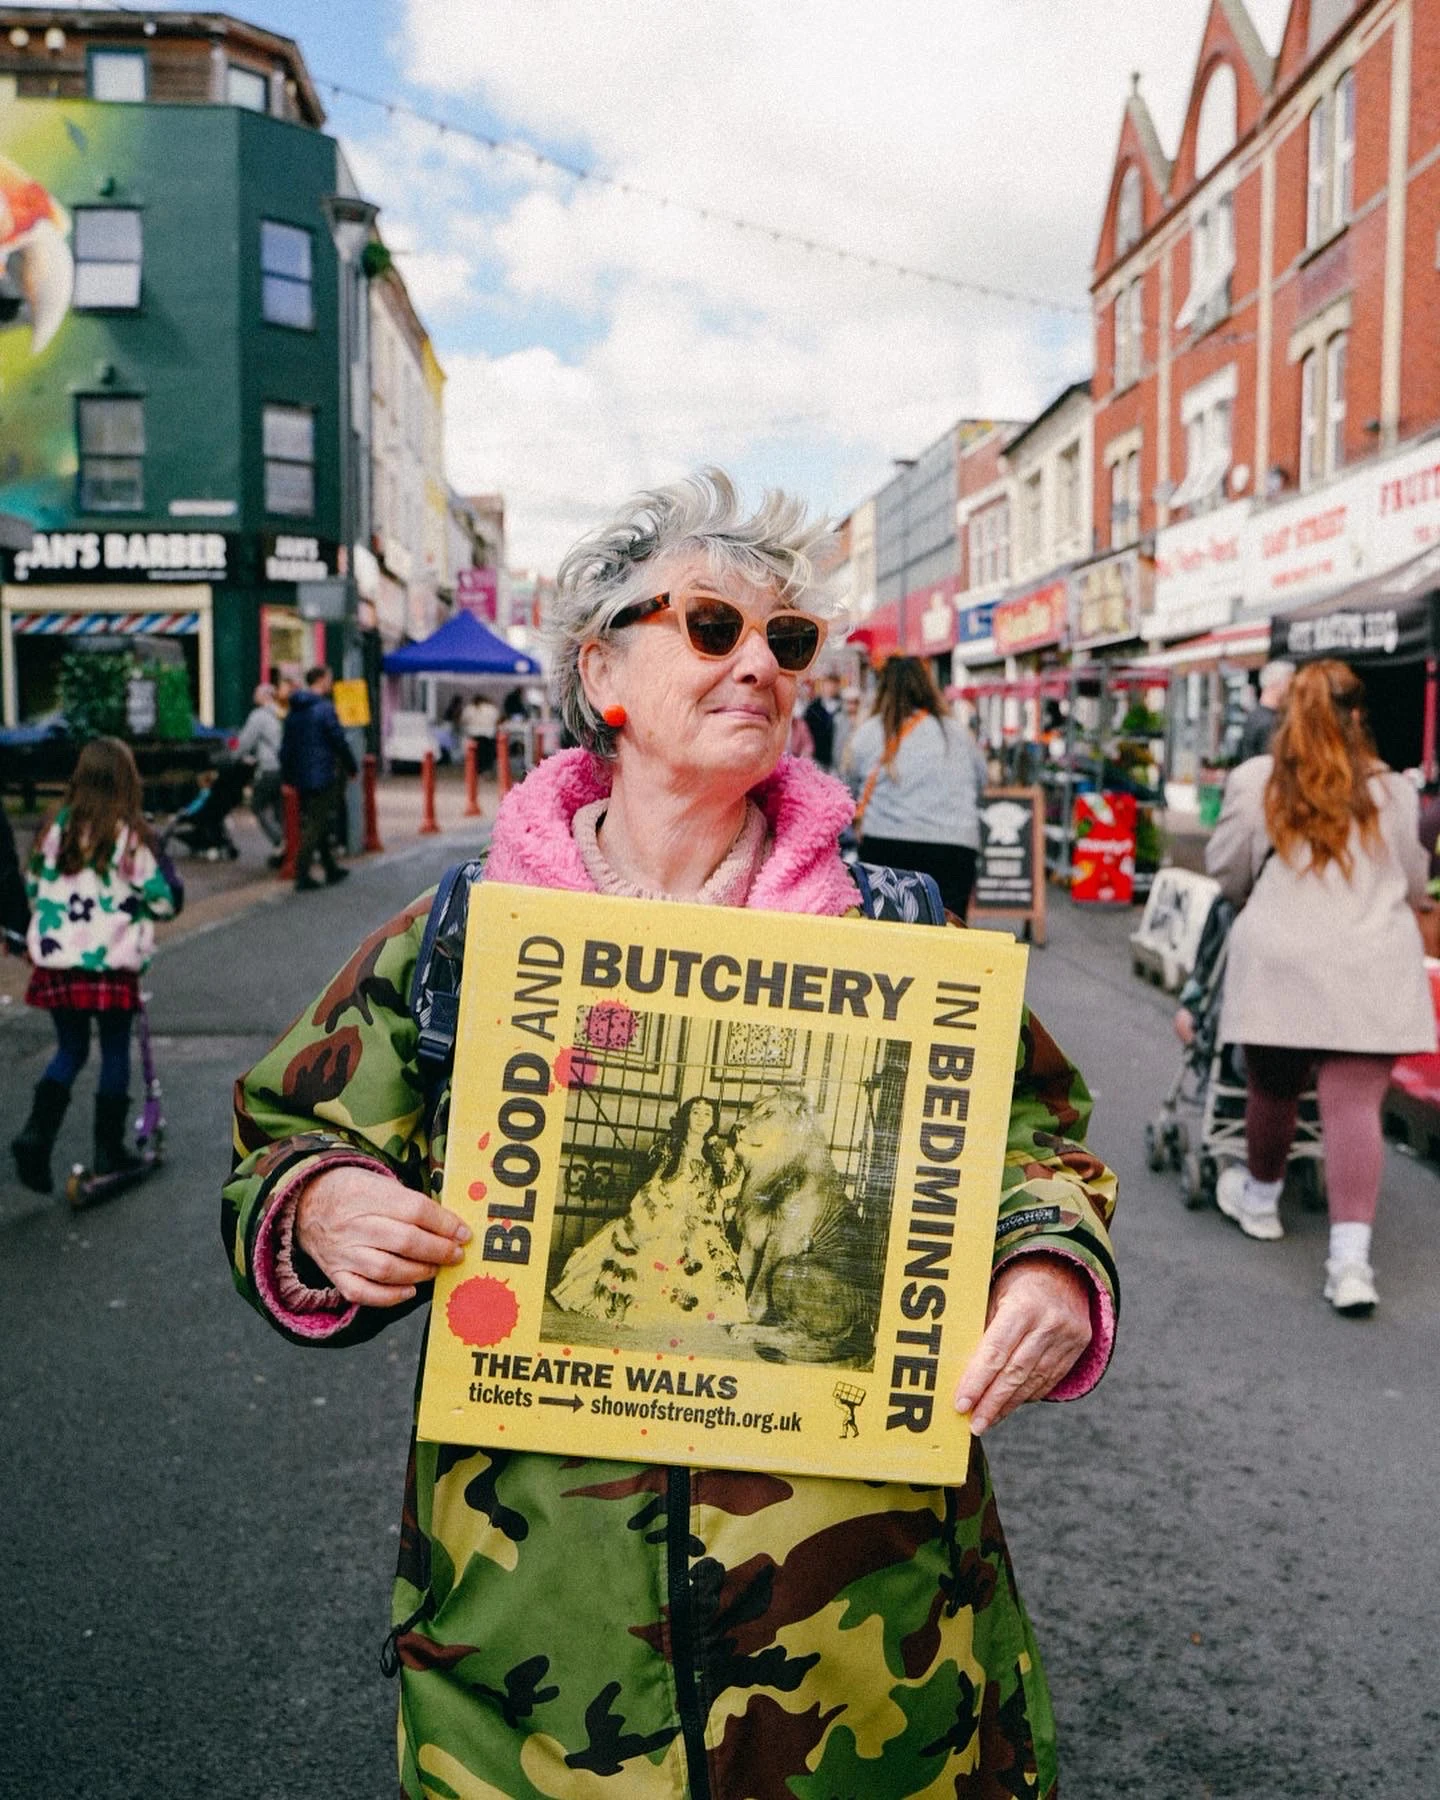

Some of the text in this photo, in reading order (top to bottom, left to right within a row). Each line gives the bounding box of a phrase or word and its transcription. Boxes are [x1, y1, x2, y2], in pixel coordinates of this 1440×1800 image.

[580, 940, 915, 1022] BUTCHERY
[482, 935, 566, 1267] BLOOD AND
[885, 982, 981, 1435] IN BEDMINSTER
[468, 1381, 803, 1434] tickets showofstrength.org.uk
[470, 1351, 739, 1401] THEATRE WALKS
